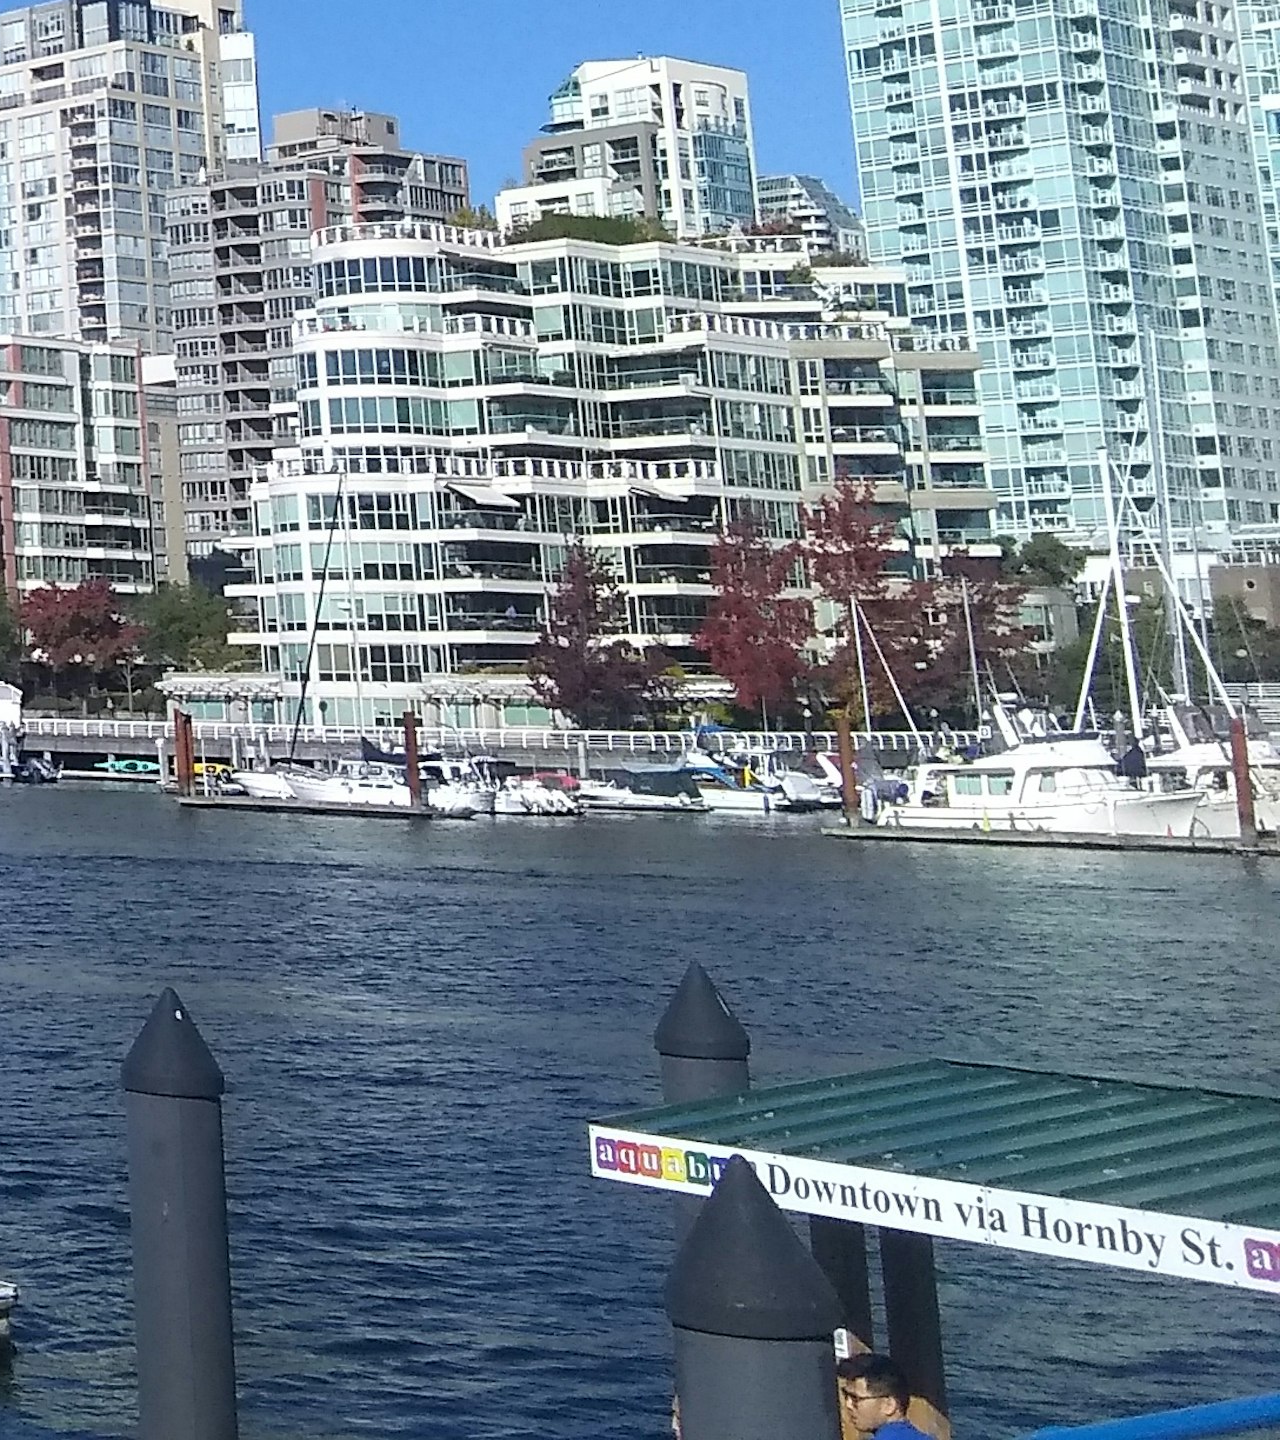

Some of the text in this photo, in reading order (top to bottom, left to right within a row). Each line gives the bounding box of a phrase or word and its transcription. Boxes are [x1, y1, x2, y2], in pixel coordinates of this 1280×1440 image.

[598, 1142, 727, 1182] aquab
[766, 1163, 943, 1222] Downtown
[954, 1196, 1007, 1233] via
[1017, 1203, 1166, 1268] Hornby
[1181, 1228, 1234, 1271] St.
